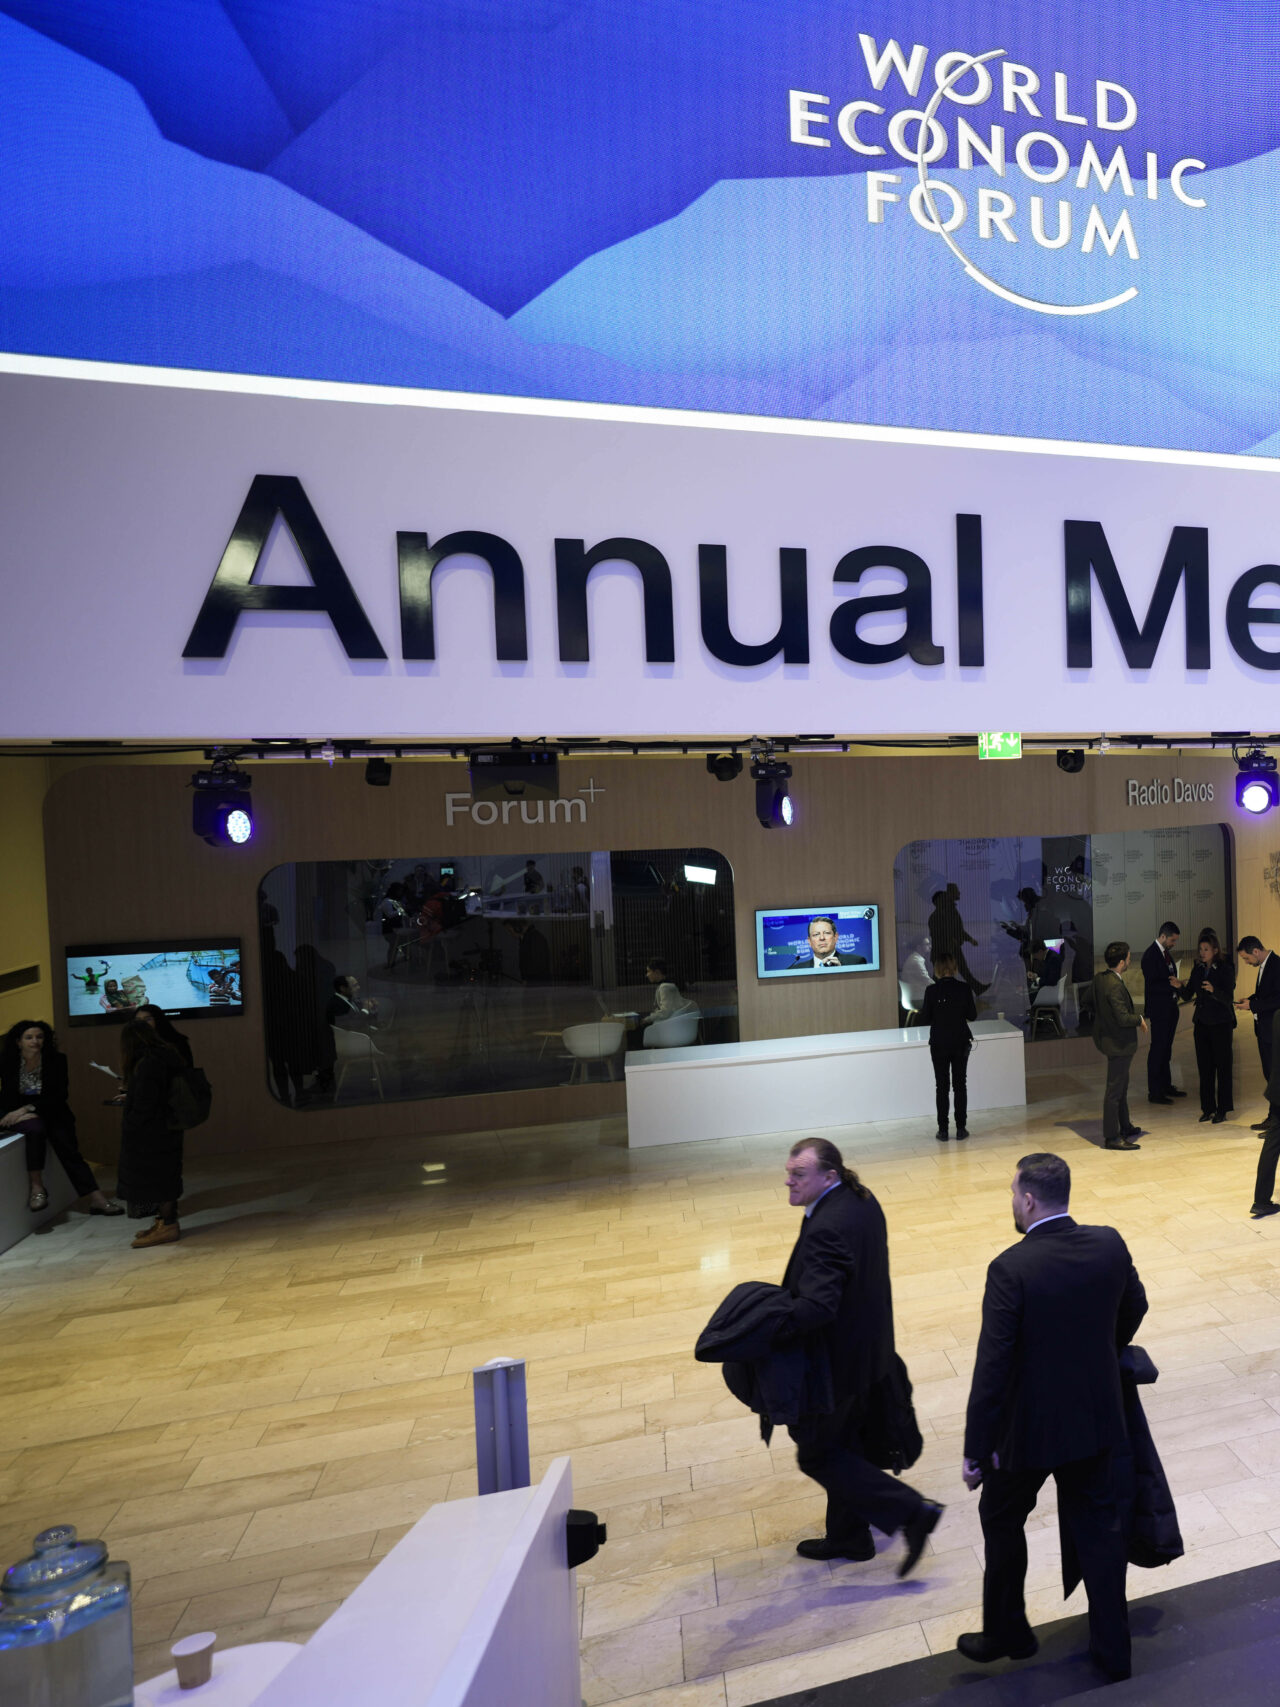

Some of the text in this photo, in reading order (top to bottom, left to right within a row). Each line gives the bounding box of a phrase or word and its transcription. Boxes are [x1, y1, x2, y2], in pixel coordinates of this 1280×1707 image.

[857, 33, 1139, 132] WORLD
[788, 88, 1207, 208] ECONOMIC
[866, 168, 1140, 261] FORUM
[181, 474, 985, 667] Annual
[1127, 777, 1214, 806] Radio Davos
